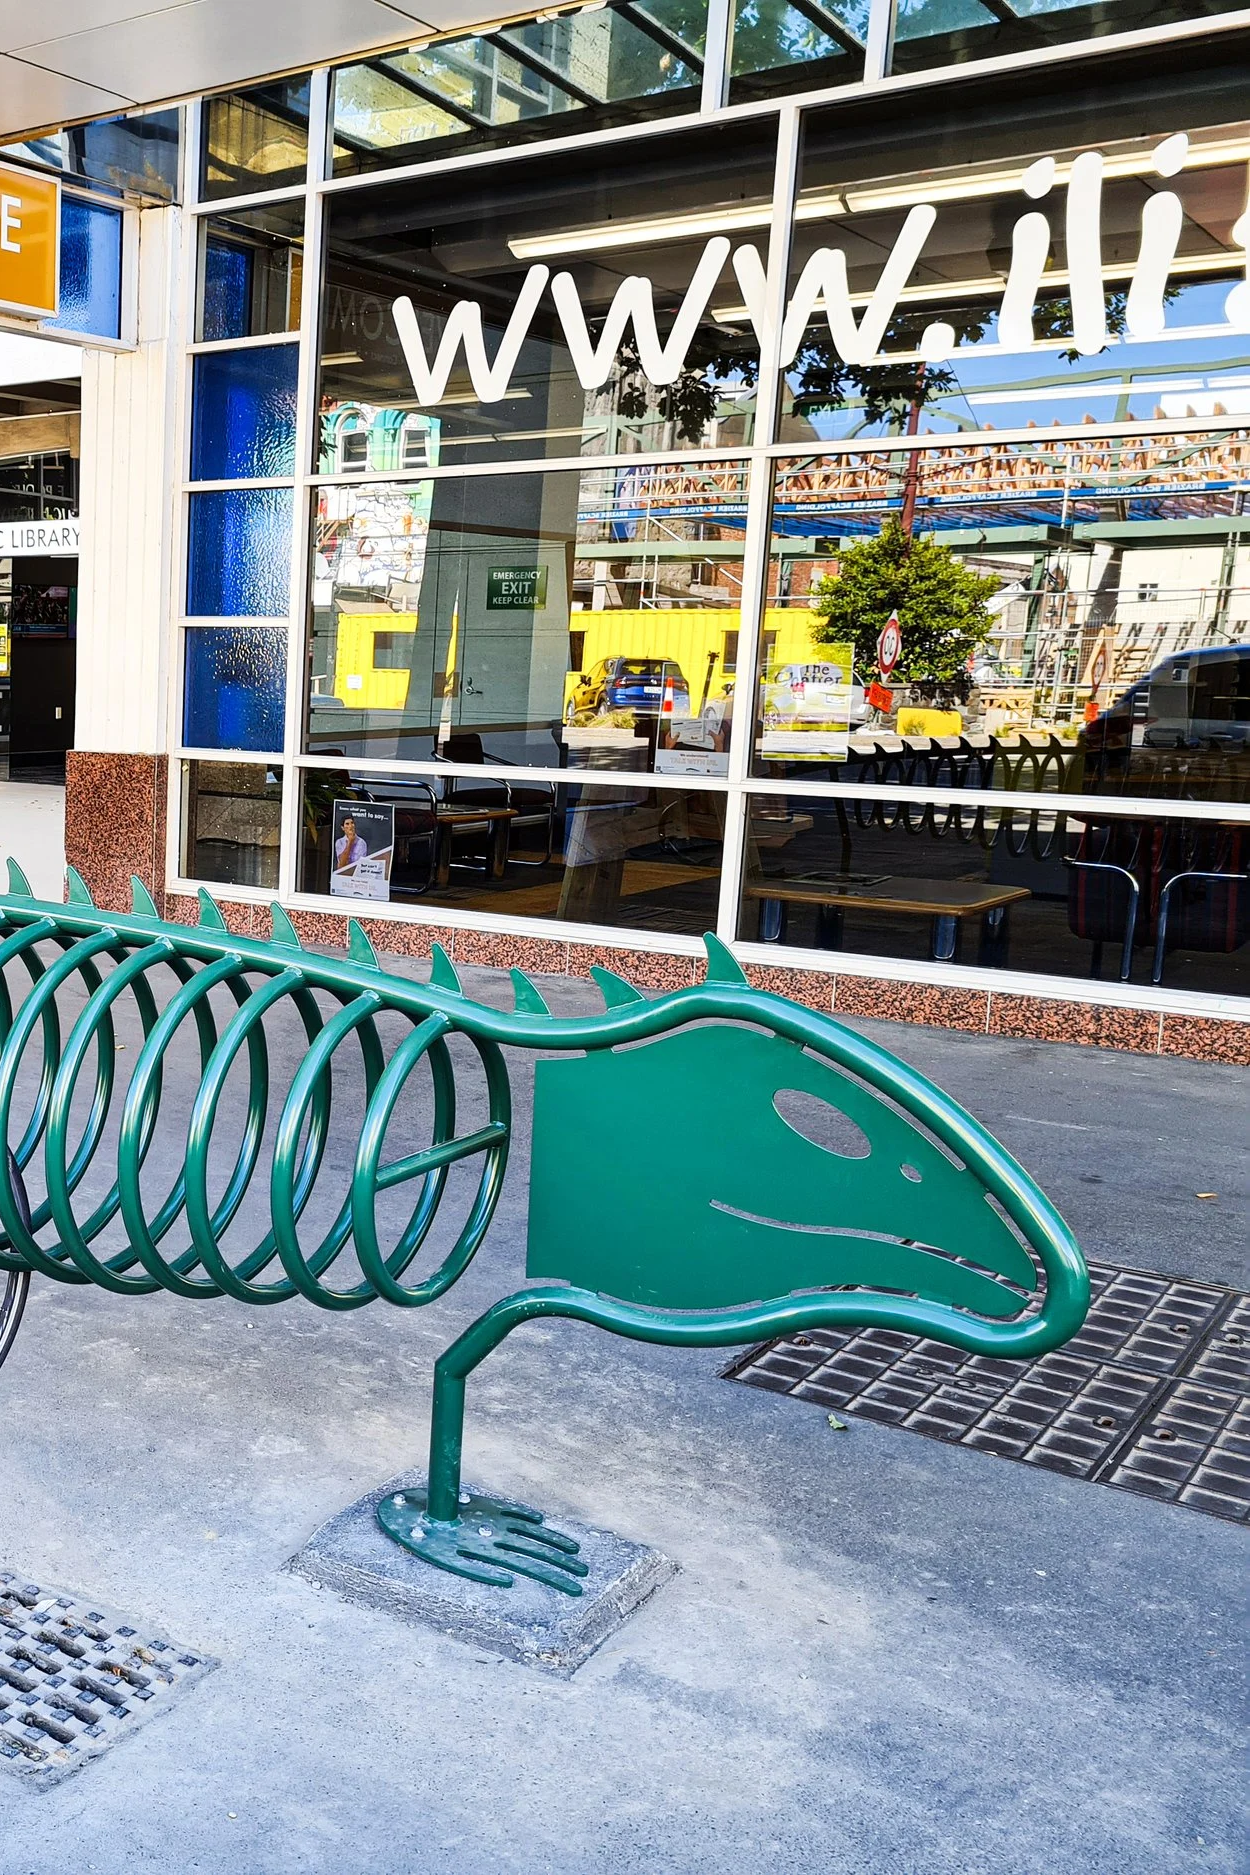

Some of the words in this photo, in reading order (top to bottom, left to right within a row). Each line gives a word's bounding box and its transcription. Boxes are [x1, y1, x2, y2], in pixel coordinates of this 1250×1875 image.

[391, 132, 1250, 408] www.ili
[11, 527, 80, 549] LIBRARY
[492, 571, 542, 580] EMERGENCY
[501, 581, 532, 595] EXIT
[492, 596, 512, 605] KEEP
[513, 595, 540, 605] CLEAR
